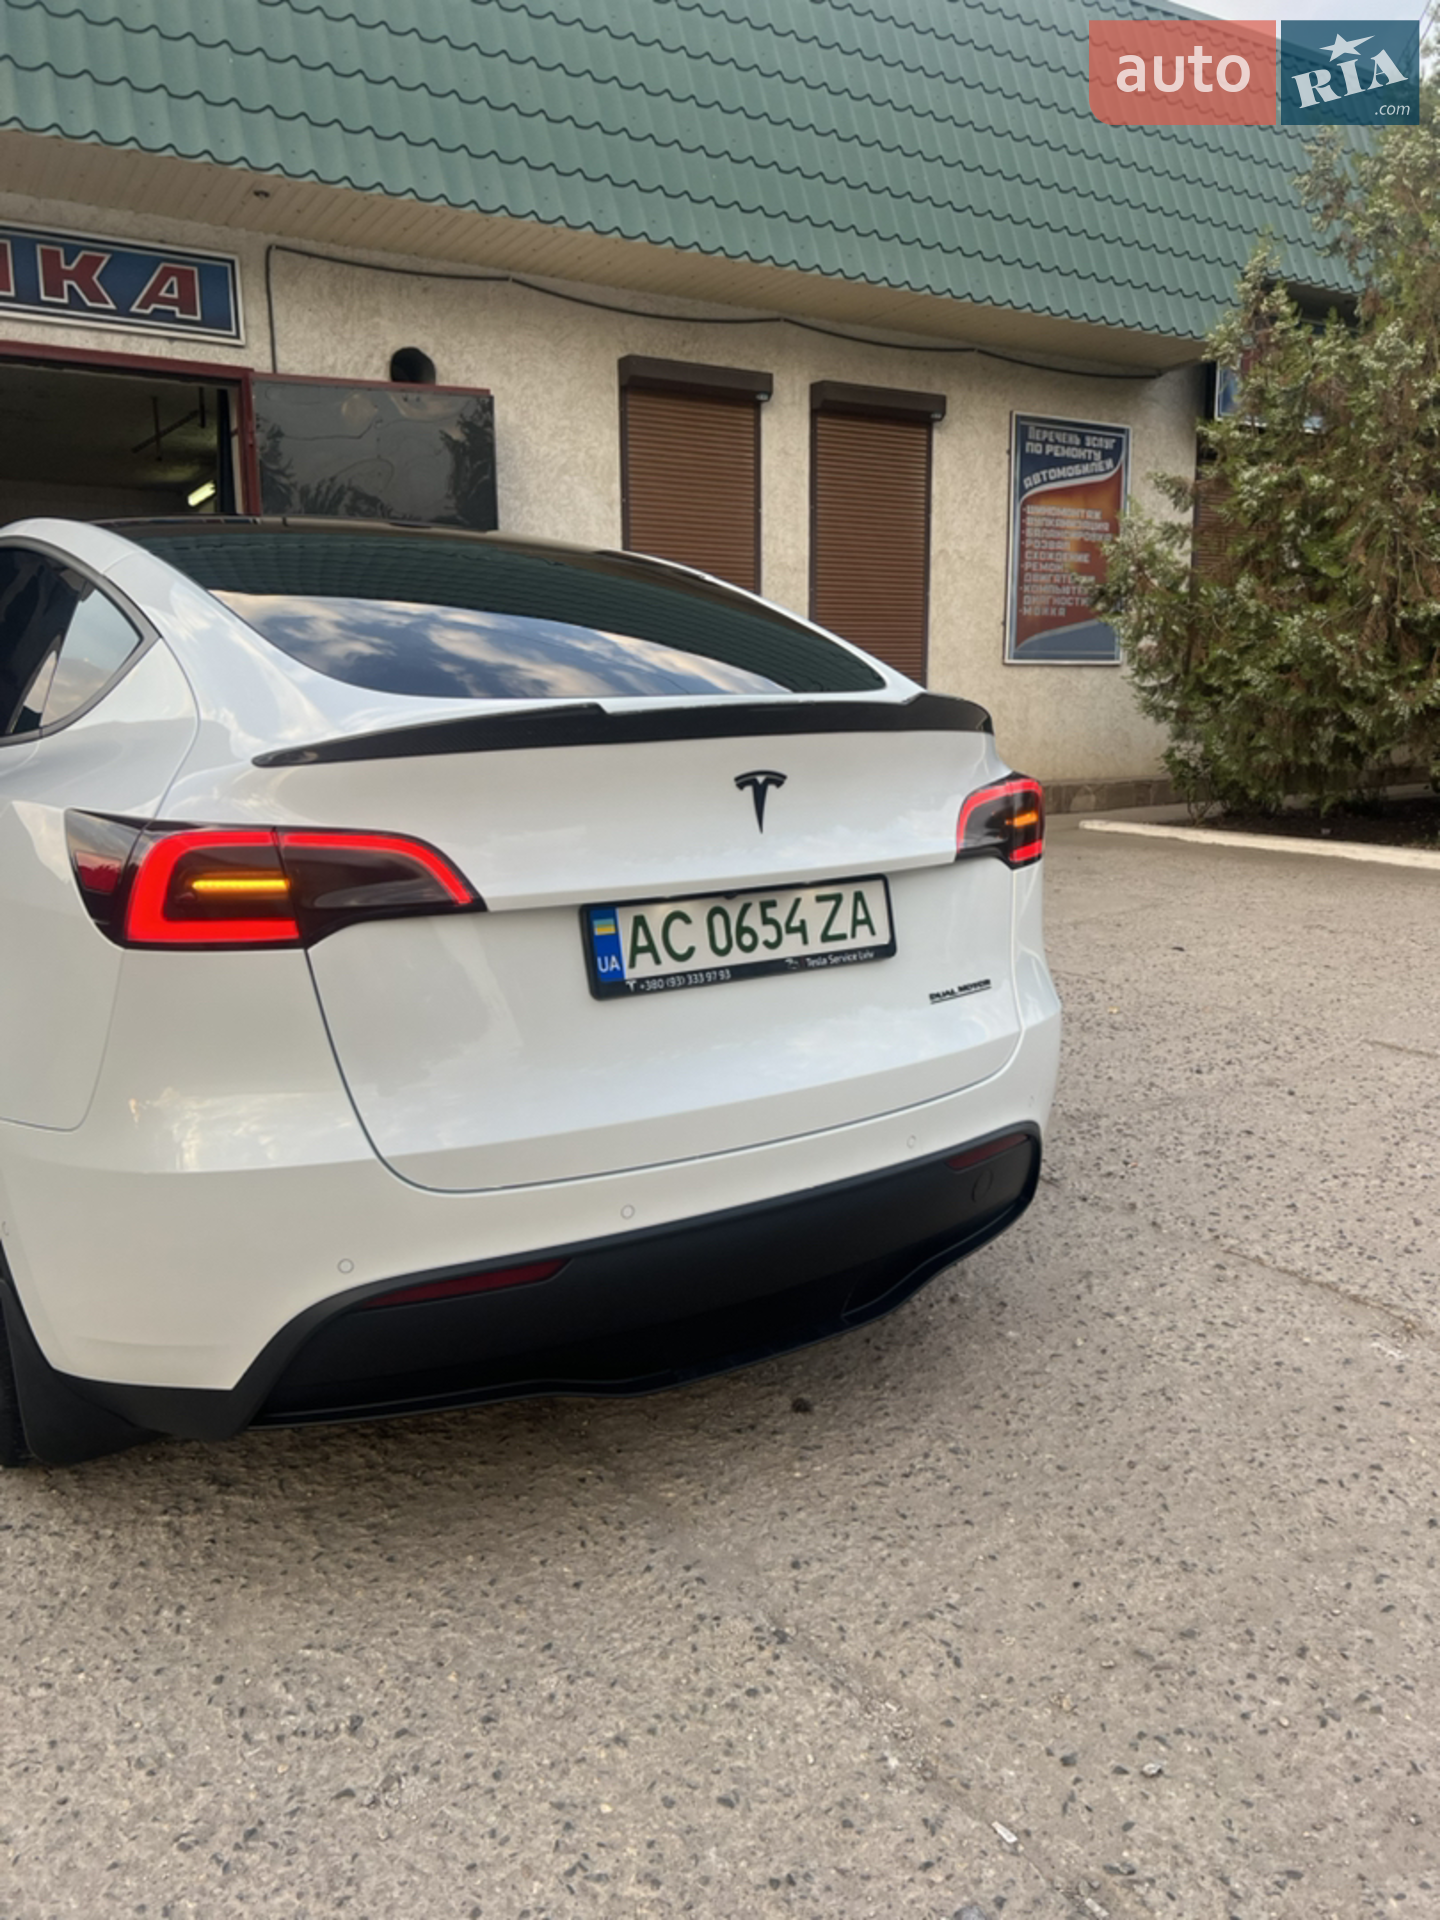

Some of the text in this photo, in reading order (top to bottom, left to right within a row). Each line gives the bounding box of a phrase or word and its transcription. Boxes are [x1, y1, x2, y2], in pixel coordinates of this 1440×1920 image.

[0, 239, 201, 320] КА
[1025, 441, 1102, 461] ПО РЕМОНТУ
[1023, 458, 1114, 489] АВТОМОБИЛЕЙ
[628, 890, 876, 969] AC 0654 ZA
[597, 955, 621, 973] UA
[805, 956, 828, 968] Tesla
[828, 952, 857, 964] Service
[639, 978, 664, 991] +380
[666, 975, 685, 988] (93)
[686, 972, 704, 985] 333
